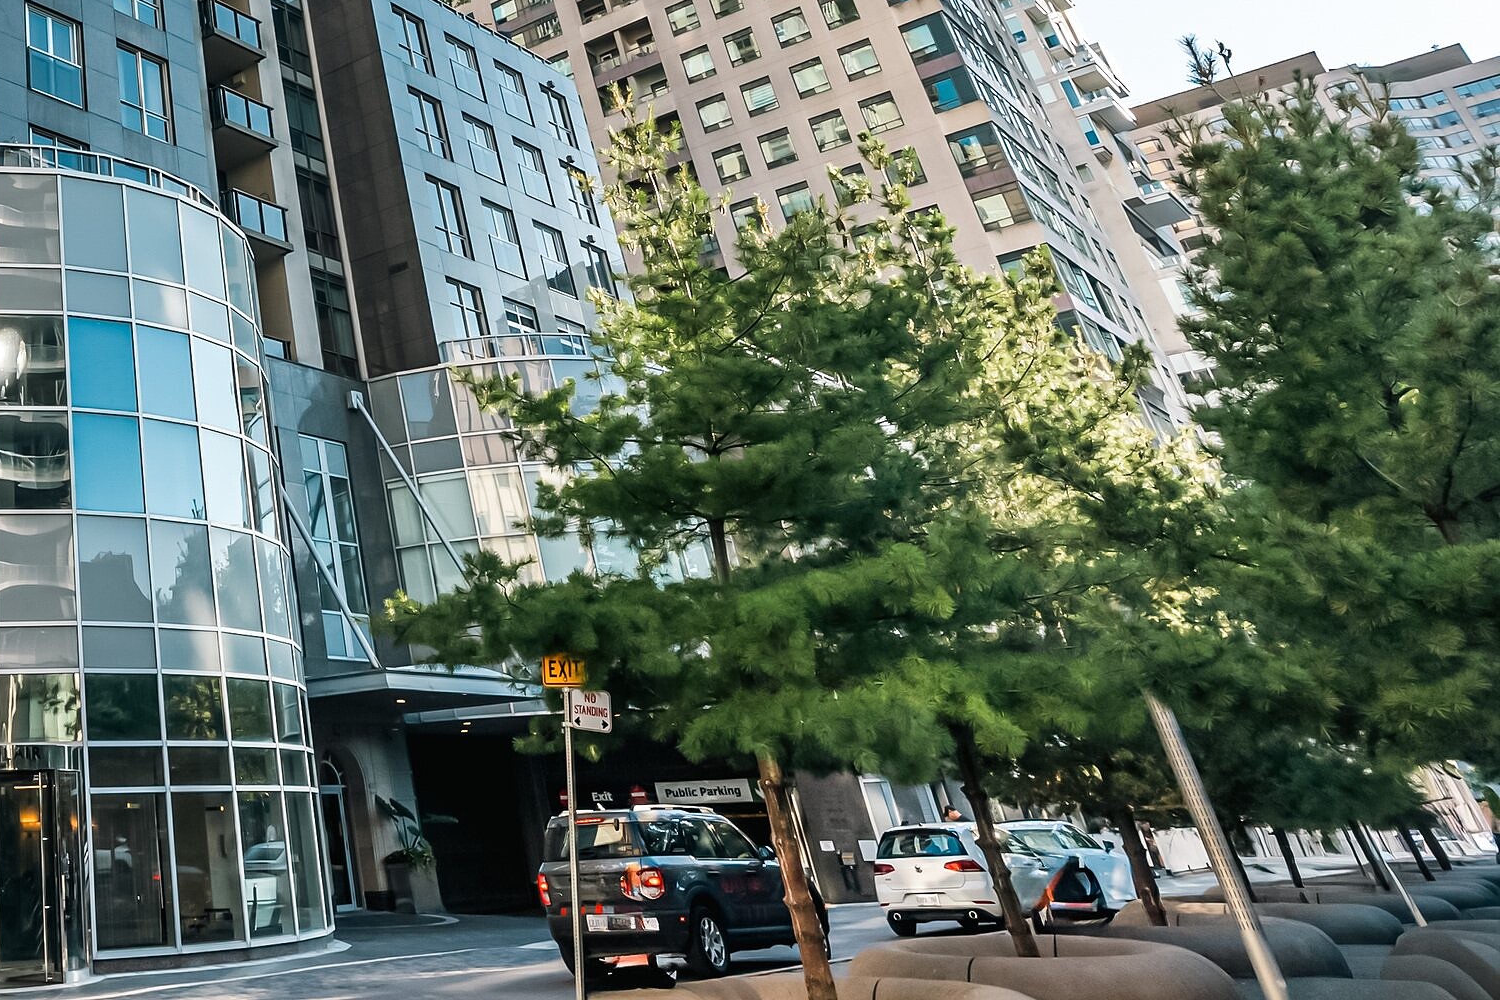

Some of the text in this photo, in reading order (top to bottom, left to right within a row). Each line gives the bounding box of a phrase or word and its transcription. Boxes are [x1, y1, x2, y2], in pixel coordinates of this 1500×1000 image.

[548, 659, 579, 679] EXIT
[584, 692, 597, 704] NO
[573, 704, 609, 718] STANDING
[591, 791, 613, 802] Exit
[665, 786, 742, 798] Public Parking
